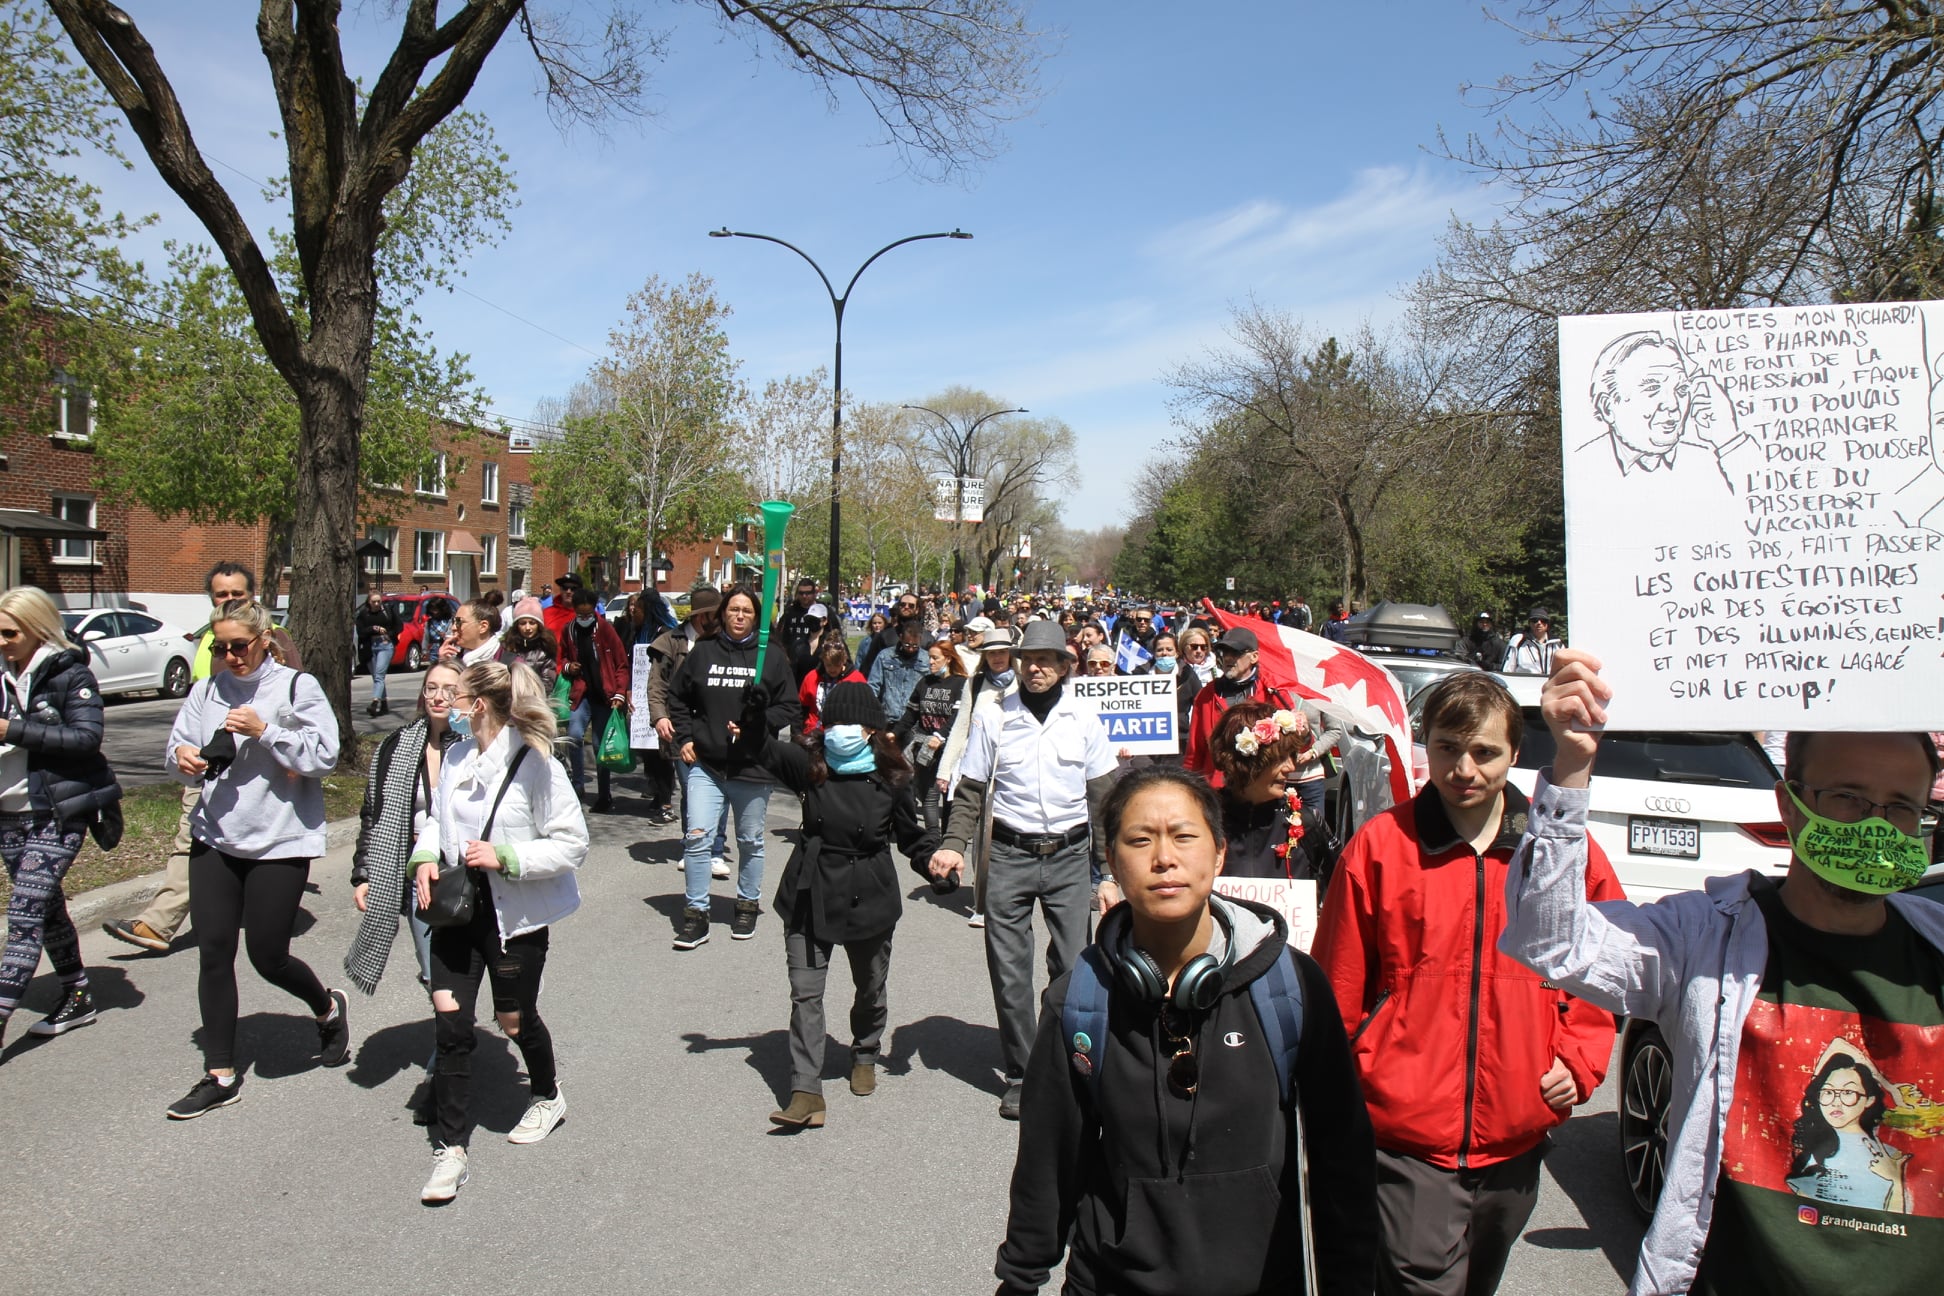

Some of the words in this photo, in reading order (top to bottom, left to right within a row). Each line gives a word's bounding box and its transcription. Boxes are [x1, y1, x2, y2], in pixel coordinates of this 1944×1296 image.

[1681, 312, 1777, 330] ÉCOUTES
[1795, 310, 1835, 327] MON
[1716, 334, 1749, 353] LES
[1764, 330, 1869, 351] PHARMAS
[1708, 358, 1736, 376] ME
[1744, 354, 1795, 370] FONT
[1810, 352, 1840, 367] DE
[1856, 348, 1882, 366] LA
[1852, 366, 1920, 384] FAQUE
[1763, 396, 1798, 413] TU
[1754, 413, 1899, 441] T'ARRANGER
[1765, 441, 1827, 462] POUR
[1843, 435, 1930, 462] POUSSER
[1832, 467, 1870, 487] DU
[1746, 492, 1880, 516] PASSEPORT
[1655, 545, 1678, 562] JE
[1866, 533, 1942, 556] PASSER
[1635, 572, 1673, 597] LES
[1693, 559, 1918, 592] CONTESTATAIRES
[1661, 598, 1715, 623] POUR
[1725, 598, 1765, 619] DES
[1649, 627, 1678, 648] ET
[1695, 625, 1740, 646] DES
[1653, 656, 1673, 671] ET
[1686, 652, 1728, 671] MET
[1840, 645, 1910, 672] LAGACÉ
[707, 678, 721, 686] DU
[1074, 680, 1172, 697] RESPECTEZ
[1669, 678, 1711, 698] SUR
[1723, 679, 1747, 701] LE
[1101, 700, 1142, 711] NOTRE
[1835, 825, 1898, 839] CANADA
[1821, 1214, 1908, 1236] grandpanda81
